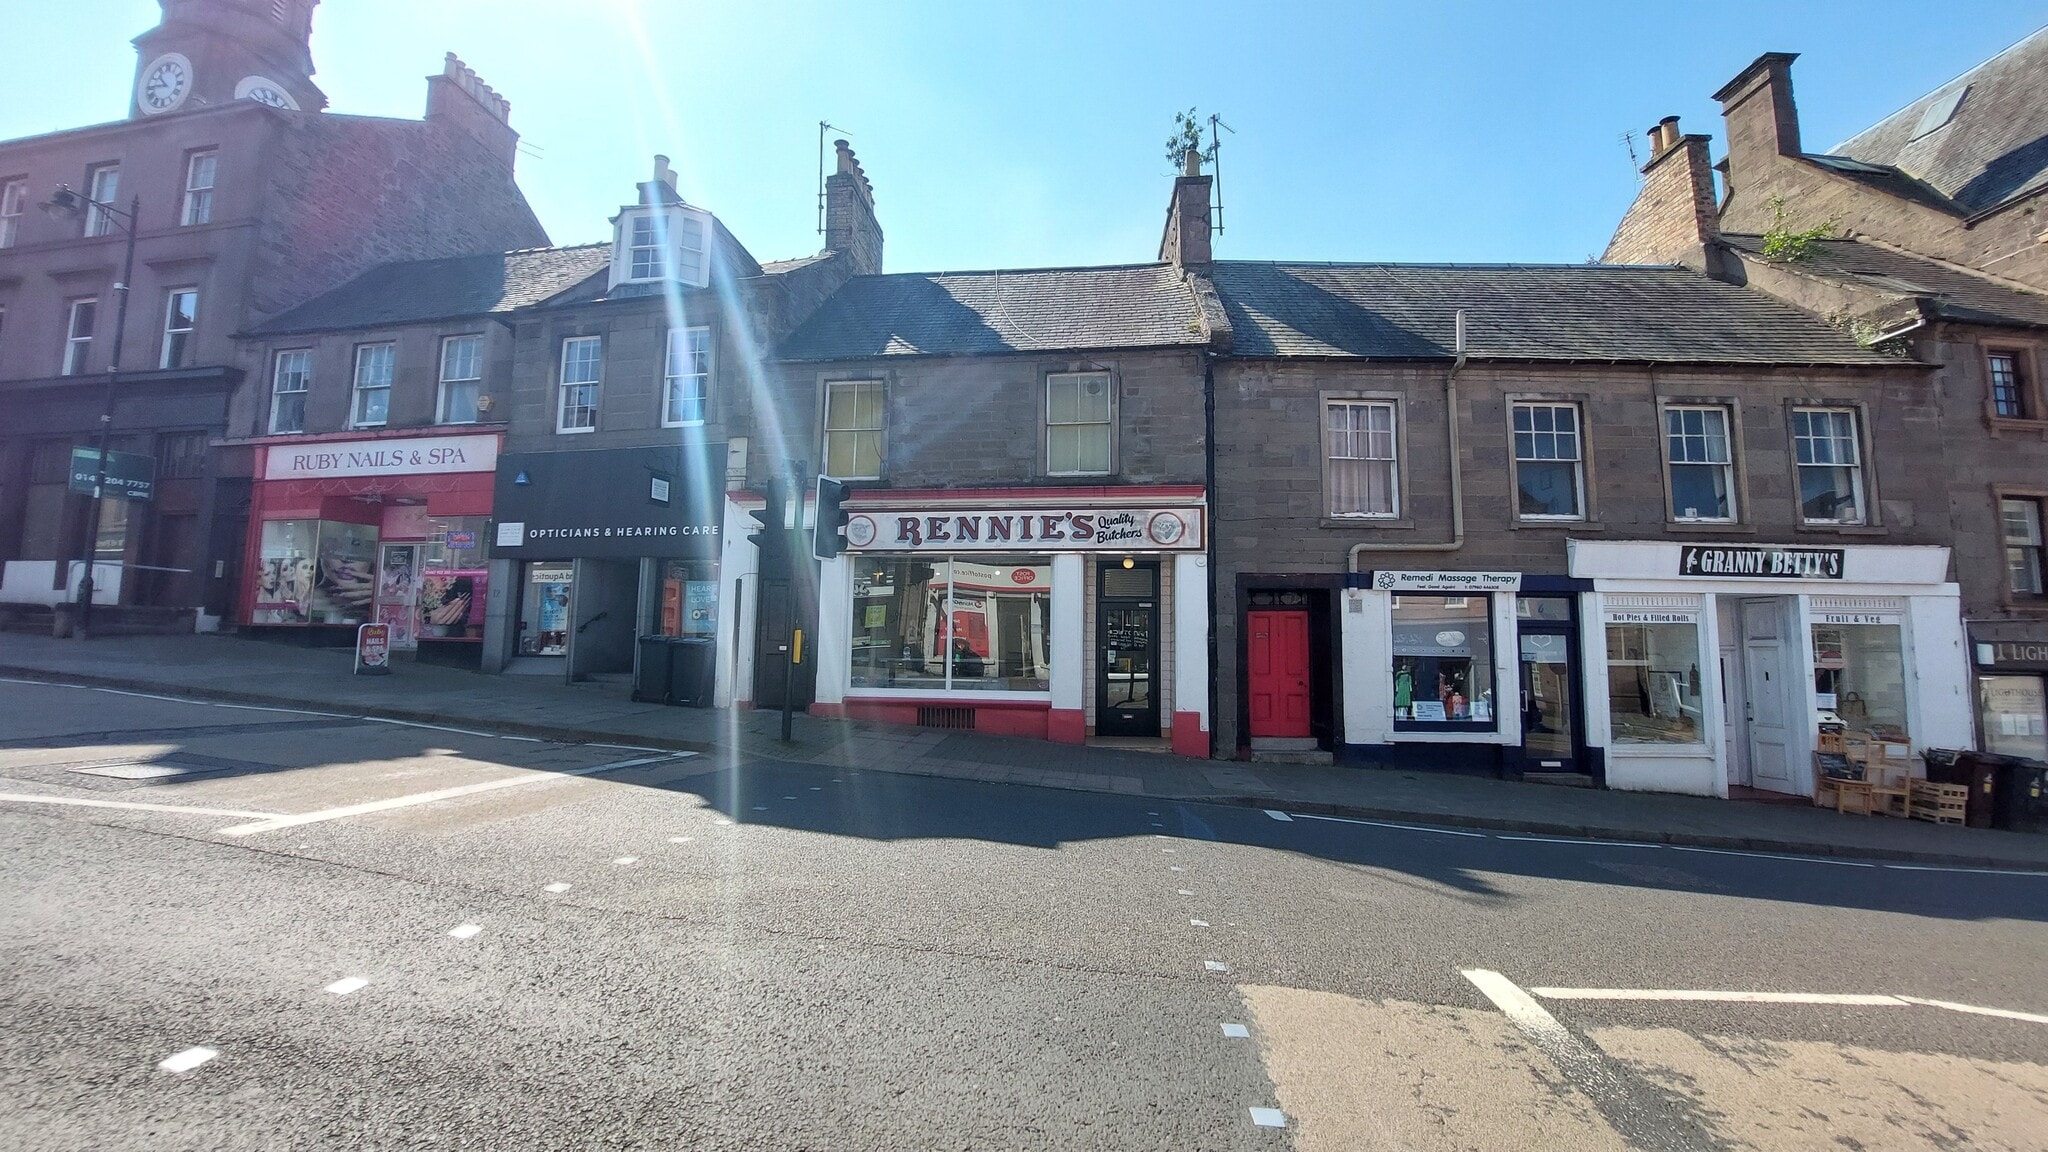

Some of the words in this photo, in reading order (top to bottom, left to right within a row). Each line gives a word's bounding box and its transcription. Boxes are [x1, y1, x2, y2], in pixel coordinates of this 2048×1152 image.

[293, 454, 342, 470] RUBY
[347, 450, 403, 468] NAILS
[409, 451, 422, 465] &
[428, 448, 466, 465] SPA
[105, 477, 124, 485] 204
[126, 480, 150, 488] 7757
[1098, 513, 1135, 529] Quality
[529, 528, 600, 538] OPTICIANS
[604, 527, 612, 537] &
[617, 527, 678, 537] HEARING
[682, 526, 719, 535] CARE
[894, 511, 1095, 546] RENNIE'S
[1096, 528, 1142, 544] Butchers
[1701, 550, 1766, 574] GRANNY
[1771, 551, 1838, 575] BETTY'S
[1401, 574, 1434, 582] Remedi
[1438, 574, 1478, 584] Massage
[1482, 574, 1517, 585] Therapy
[1612, 613, 1625, 621] Hot
[1626, 613, 1641, 621] Pies
[1672, 614, 1689, 622] Rolls
[1825, 615, 1849, 623] Fruit
[1853, 615, 1860, 623] &
[1864, 615, 1881, 623] Veg
